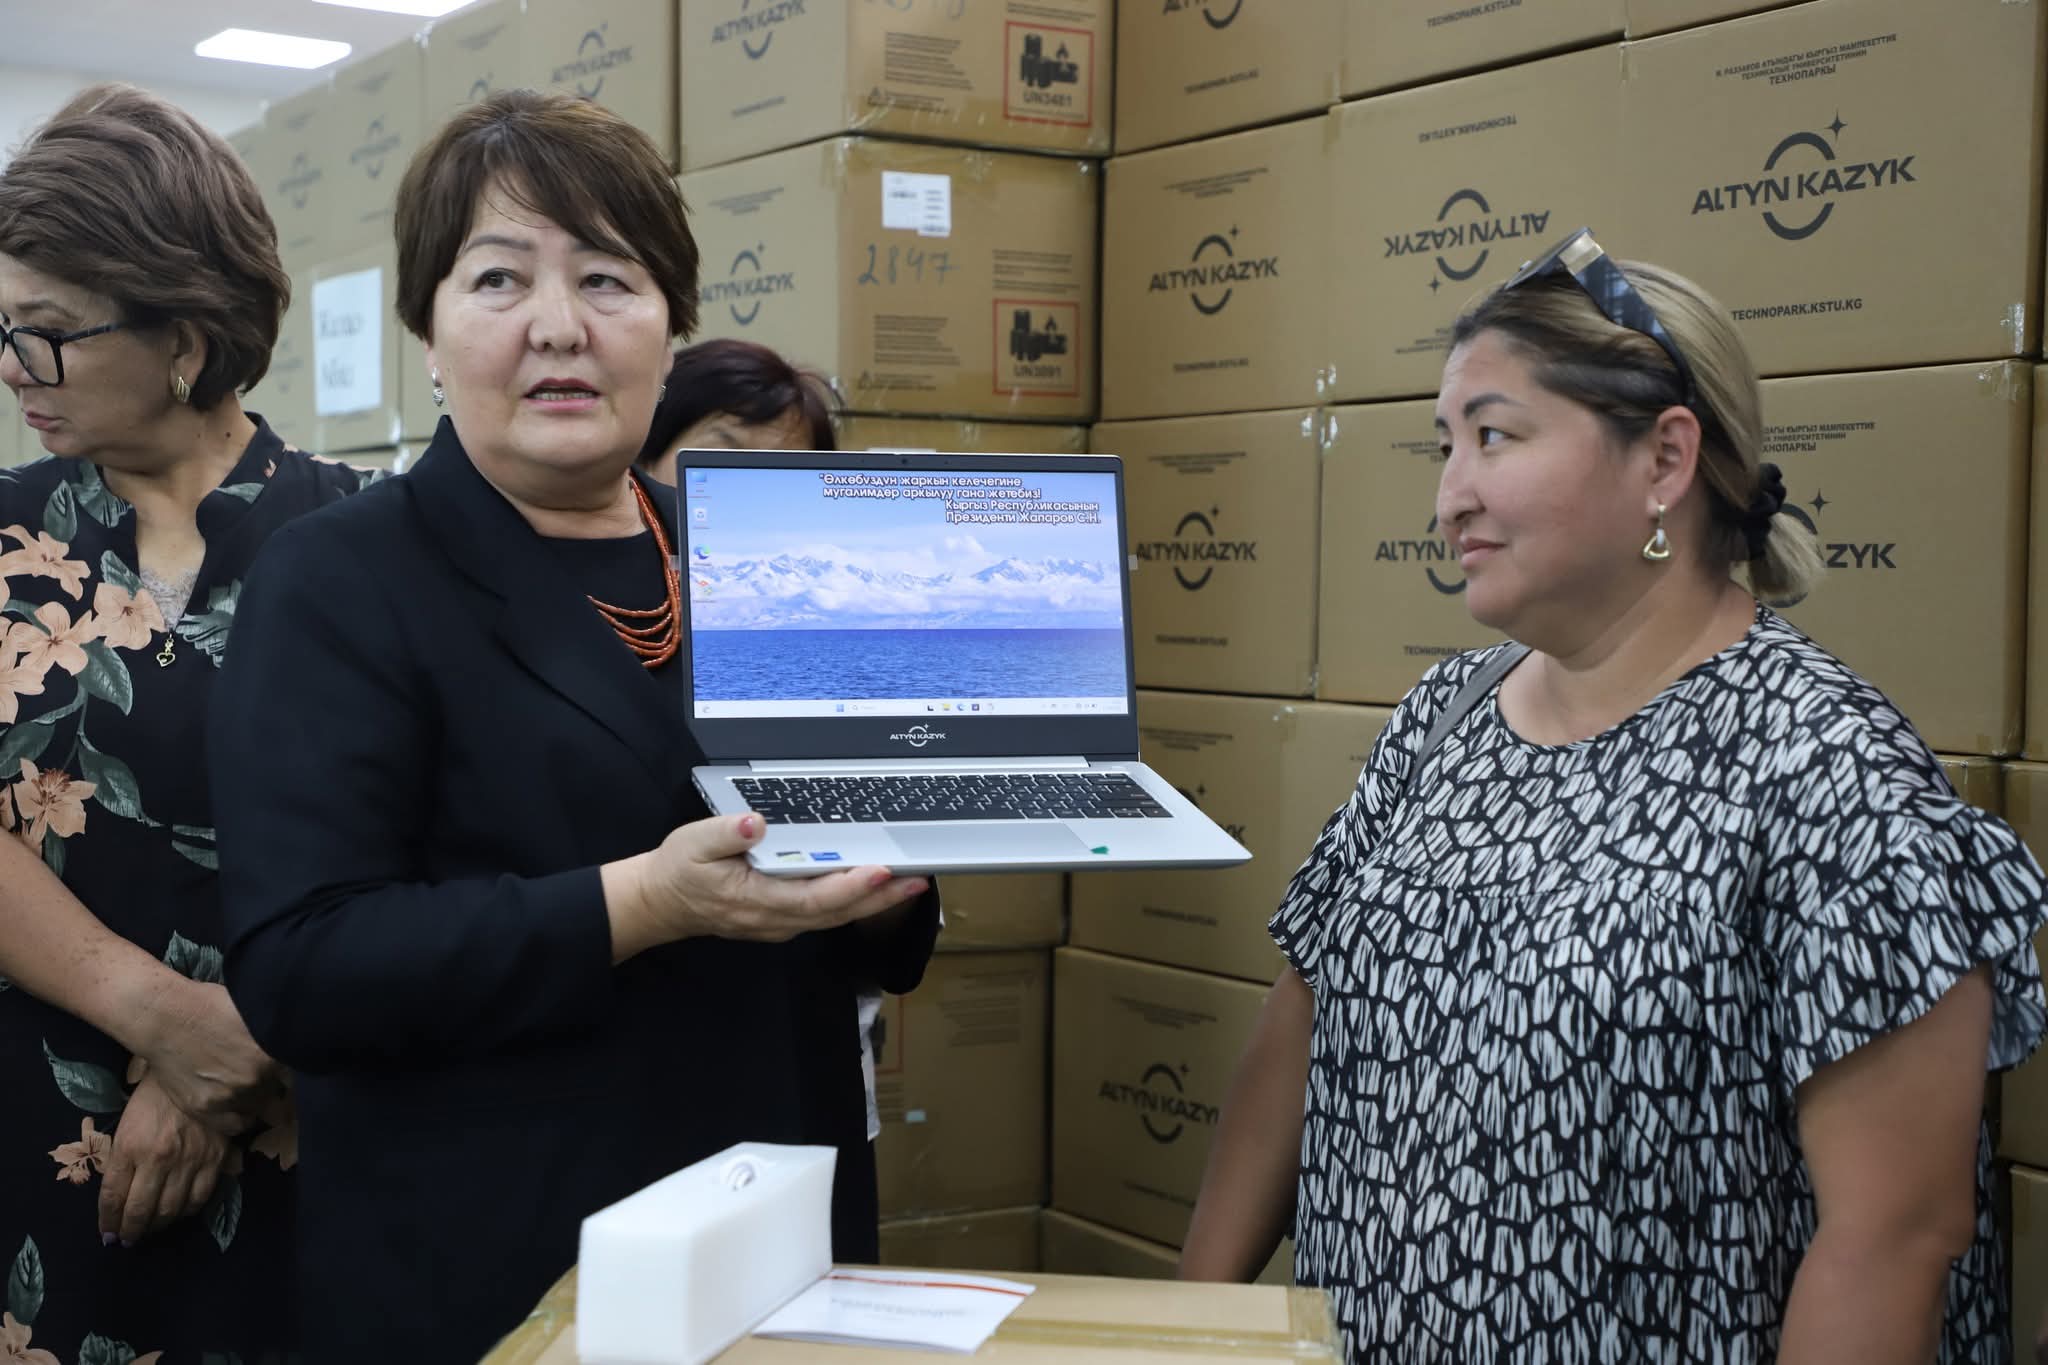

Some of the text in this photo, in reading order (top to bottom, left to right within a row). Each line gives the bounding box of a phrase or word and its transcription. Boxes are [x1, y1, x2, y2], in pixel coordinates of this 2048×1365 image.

[1769, 64, 1837, 85] ТЕХНОПАРКЫ
[1691, 155, 1917, 215] ALTYN KAZYK
[1384, 210, 1551, 258] ALTYN KAZYK
[857, 244, 961, 286] 2847
[1148, 256, 1278, 293] ALTYN KAZYK
[1731, 298, 1863, 321] TECHNOPARK.KSTU.KG
[900, 476, 950, 487] жаркын
[952, 476, 1022, 487] келечегине
[823, 487, 1042, 500] мугалимдер аркылуу гана жетебиз!
[945, 500, 1100, 512] Кыргыз Республикасынын
[946, 511, 1016, 524] Президенти
[1018, 512, 1075, 524] Жапаров
[1136, 541, 1257, 561] ALTYN KAZYK
[1375, 540, 1446, 561] ALTYN
[1823, 543, 1897, 569] ZYK
[1159, 1095, 1220, 1125] KAZY
